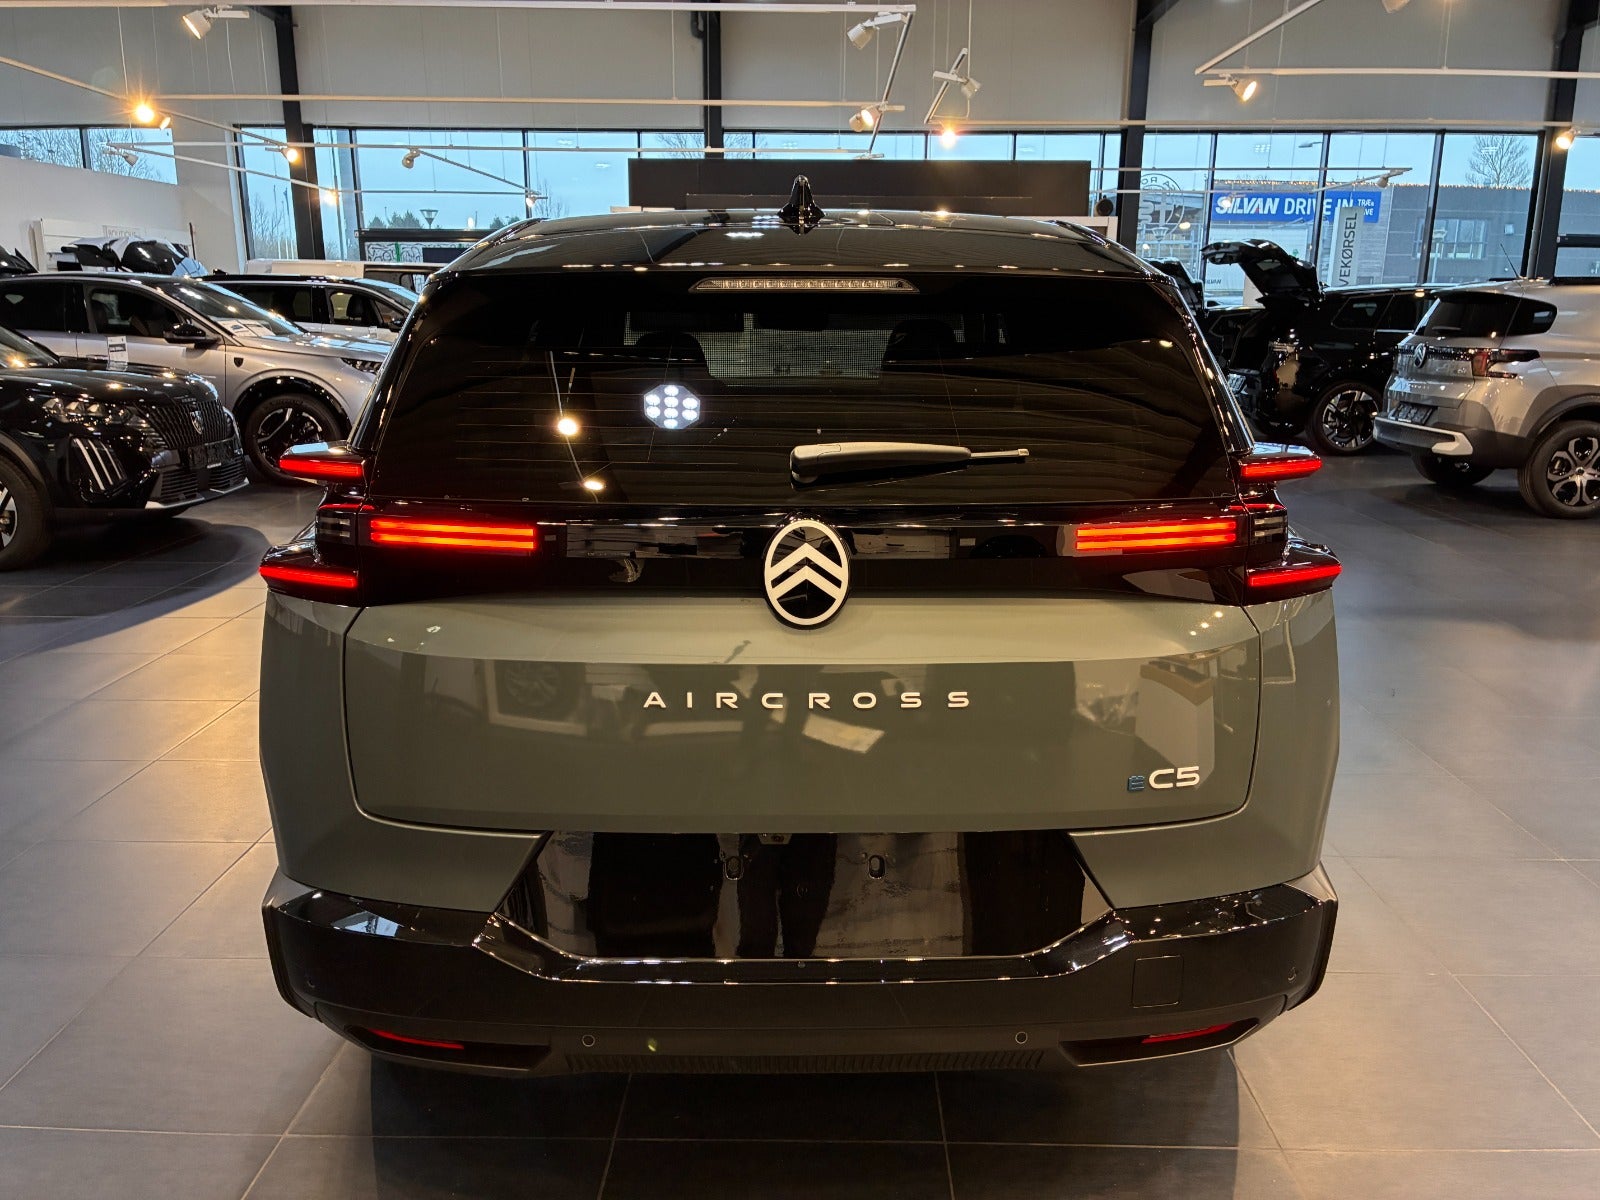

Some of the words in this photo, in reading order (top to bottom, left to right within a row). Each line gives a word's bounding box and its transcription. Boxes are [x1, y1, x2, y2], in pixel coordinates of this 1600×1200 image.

[1215, 197, 1280, 214] SILVAN
[1339, 213, 1357, 287] VEKØRSEL
[643, 691, 970, 709] AIRCROSS
